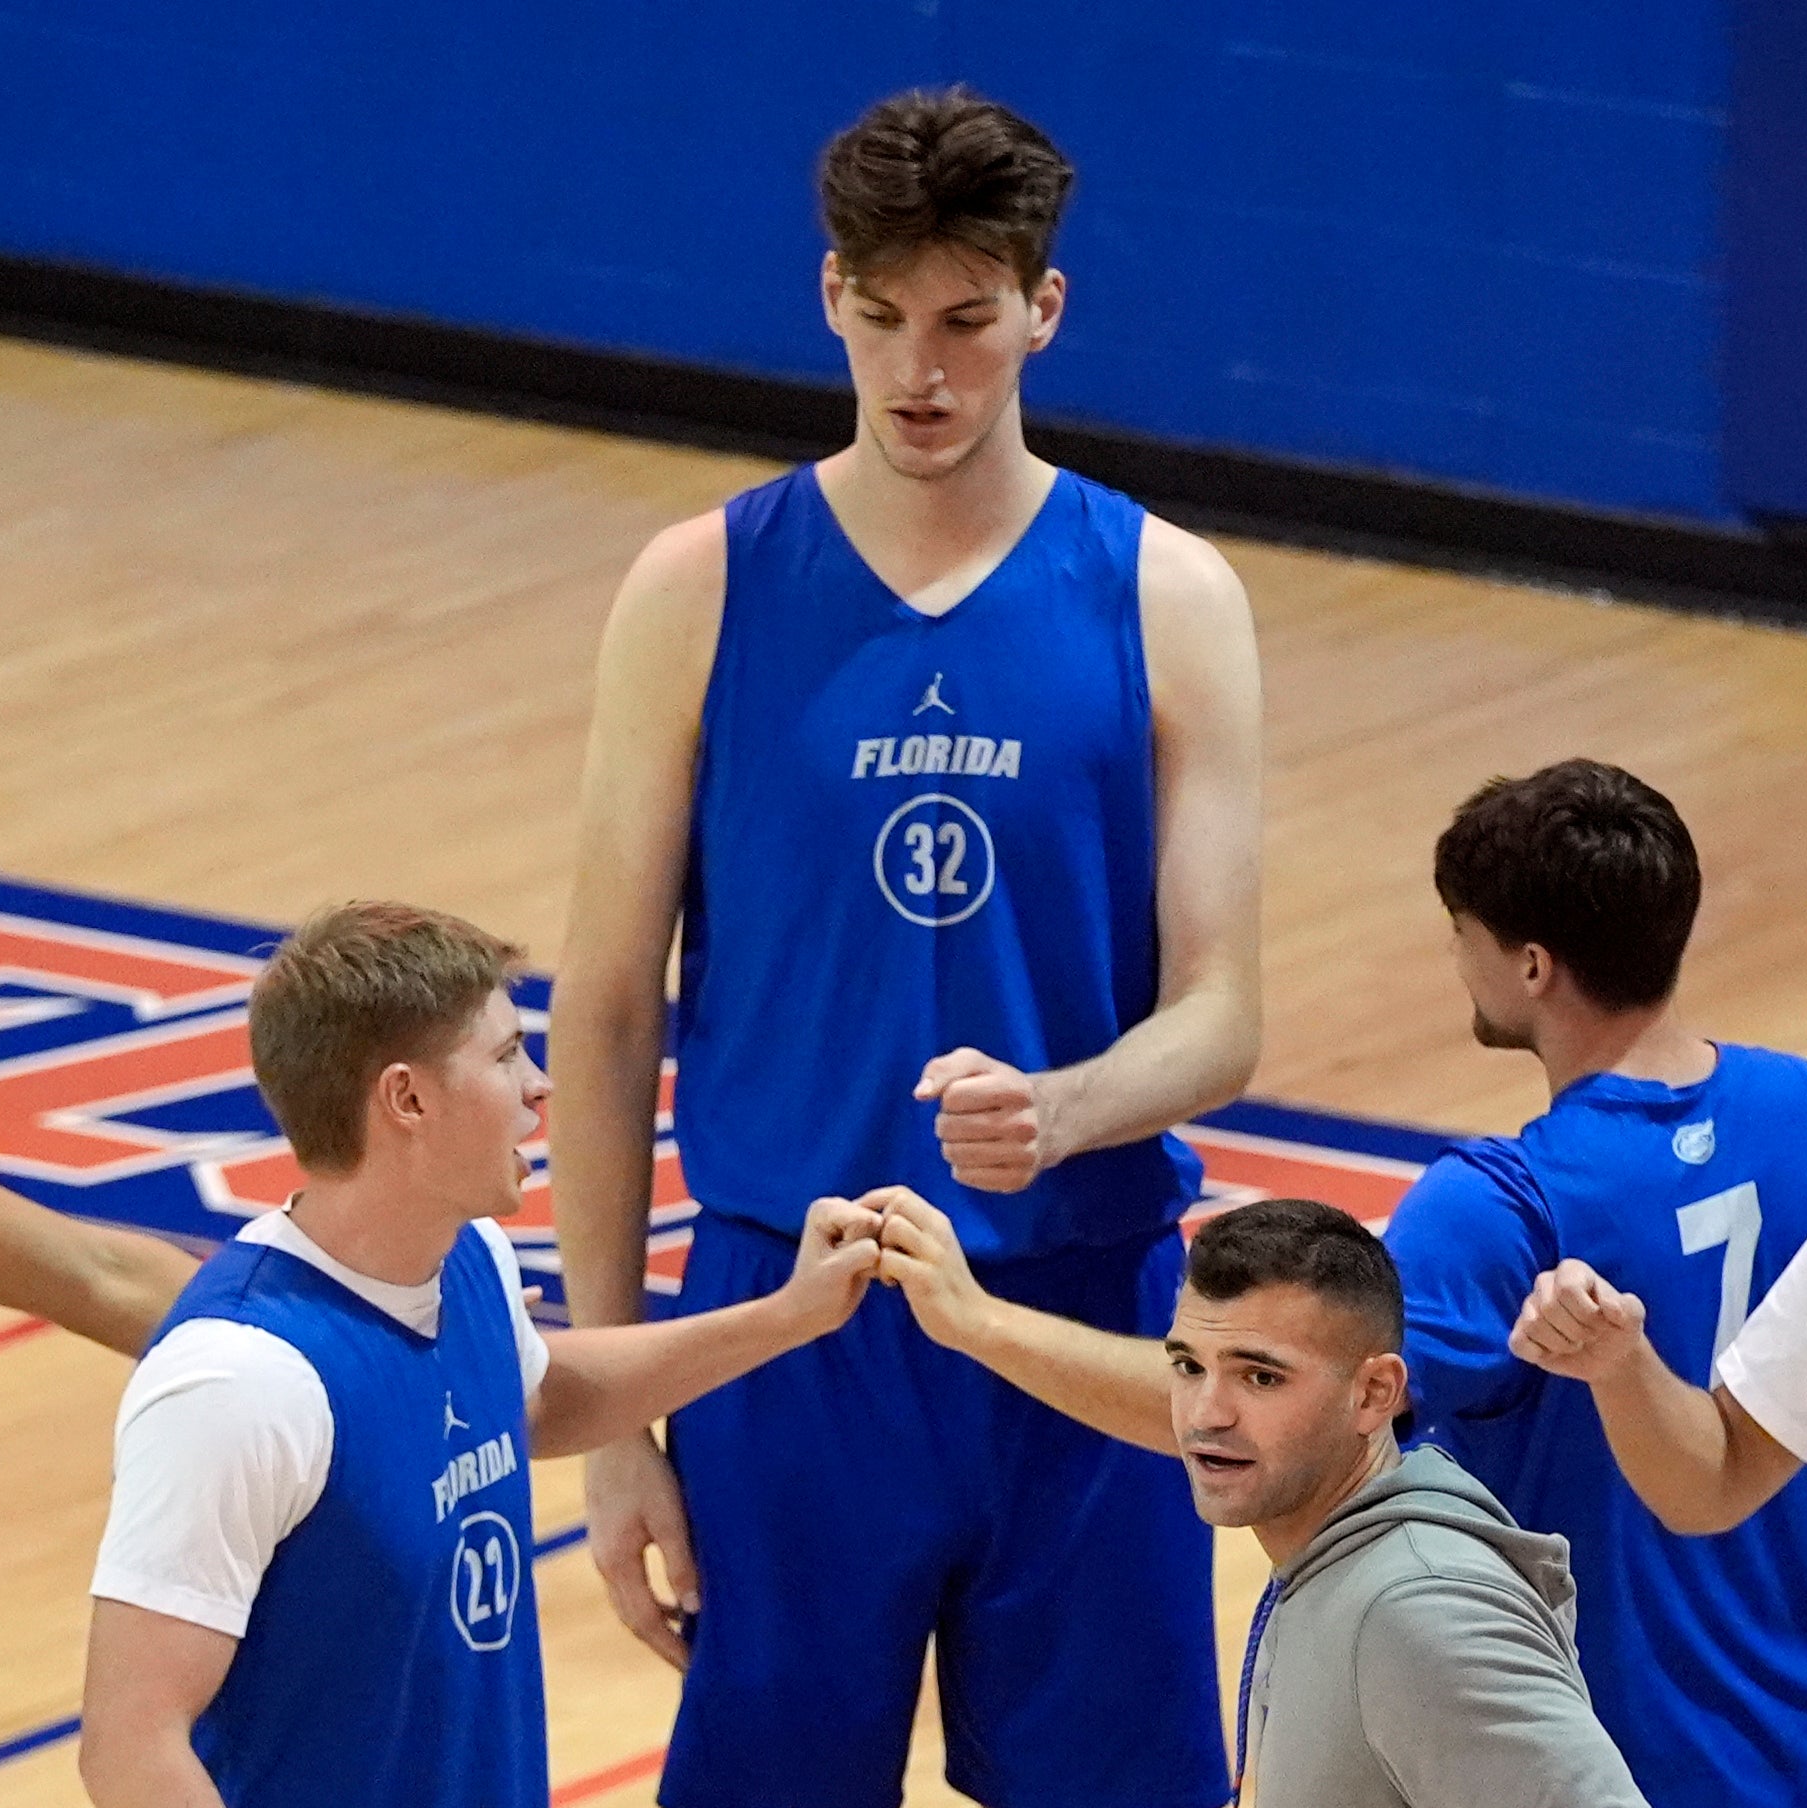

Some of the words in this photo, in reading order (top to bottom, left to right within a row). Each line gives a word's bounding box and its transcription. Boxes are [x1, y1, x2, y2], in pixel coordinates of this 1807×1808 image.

[850, 735, 1022, 779] FLORIDA
[904, 821, 968, 895] 32
[1675, 1180, 1763, 1392] 7
